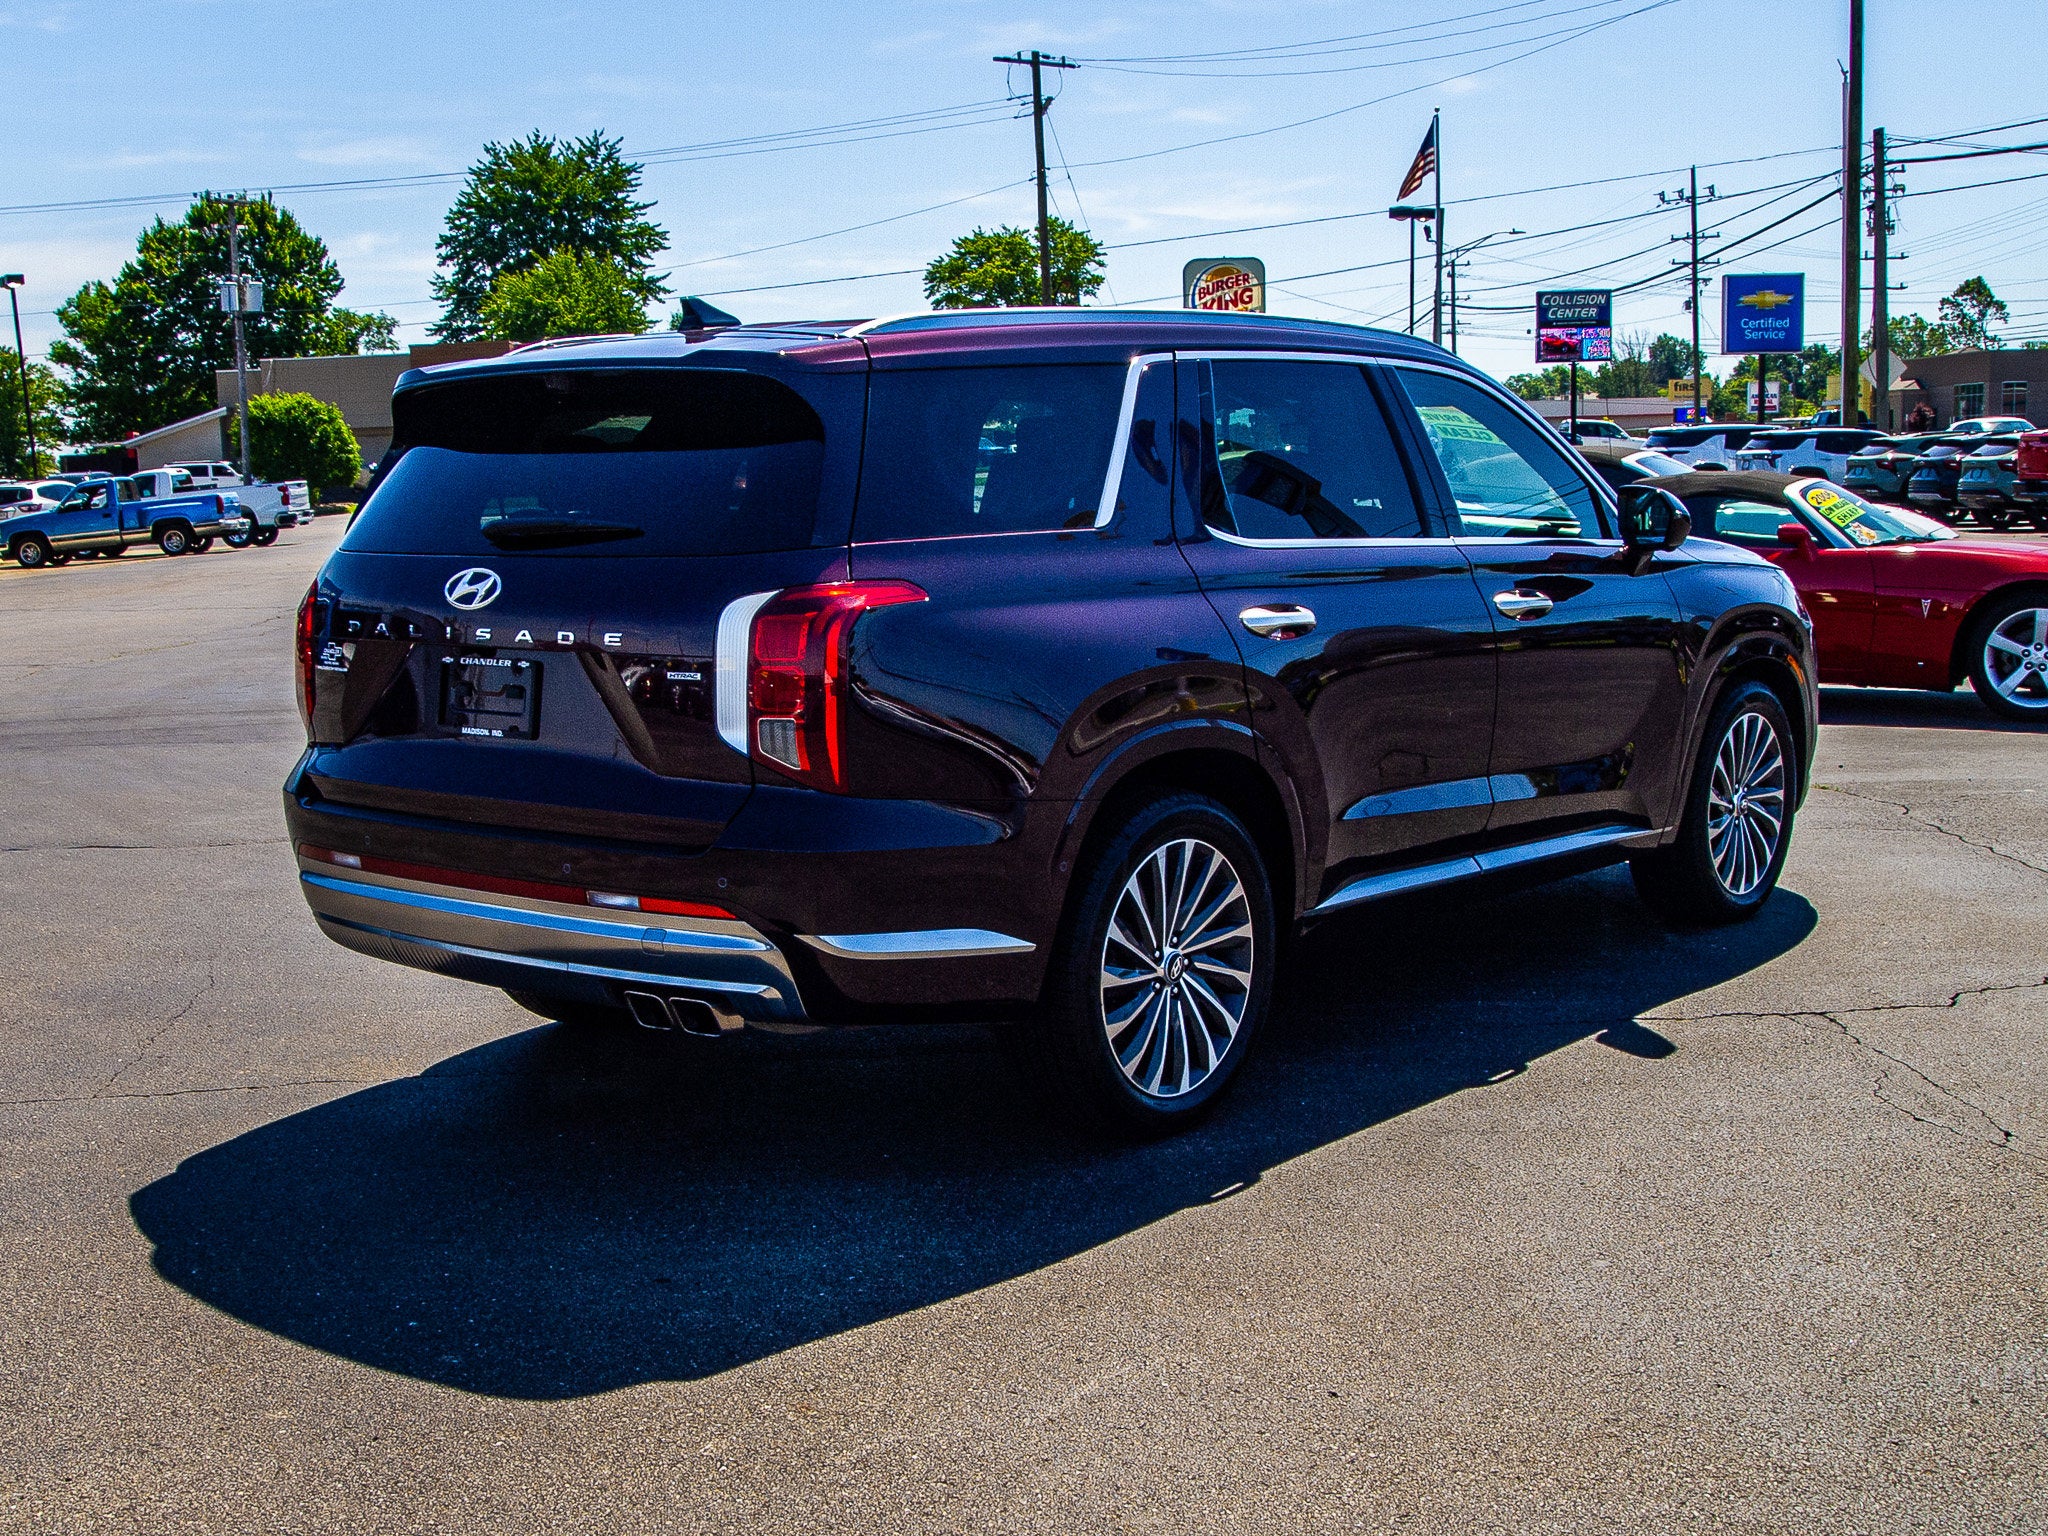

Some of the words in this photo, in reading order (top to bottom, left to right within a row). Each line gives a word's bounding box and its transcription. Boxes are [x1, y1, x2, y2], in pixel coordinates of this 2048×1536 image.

[1198, 273, 1251, 301] BURGER
[1202, 287, 1254, 311] KING
[1542, 294, 1607, 306] COLLISION
[1548, 307, 1598, 319] CENTER
[1740, 317, 1790, 329] Certified
[1744, 329, 1786, 340] Service
[348, 619, 623, 647] PALISADE
[459, 657, 512, 668] CHANDLER
